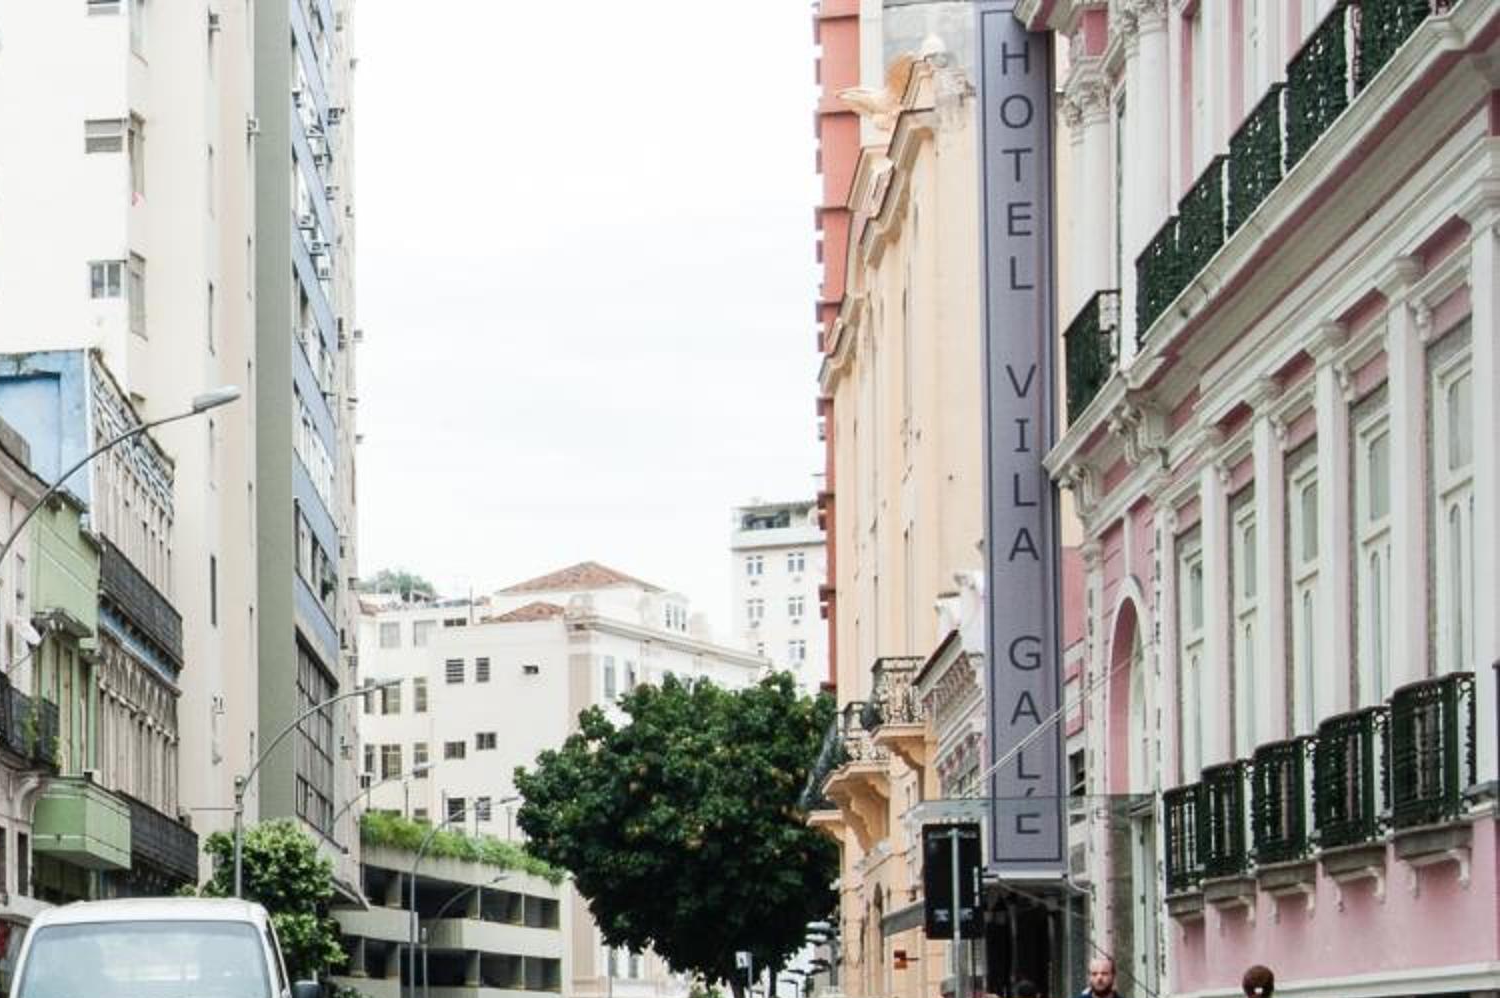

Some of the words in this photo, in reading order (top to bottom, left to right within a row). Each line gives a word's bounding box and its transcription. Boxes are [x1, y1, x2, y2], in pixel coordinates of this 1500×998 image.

[999, 40, 1035, 291] HOTEL
[1006, 364, 1041, 562] VILA
[1008, 635, 1043, 836] GALÉ
